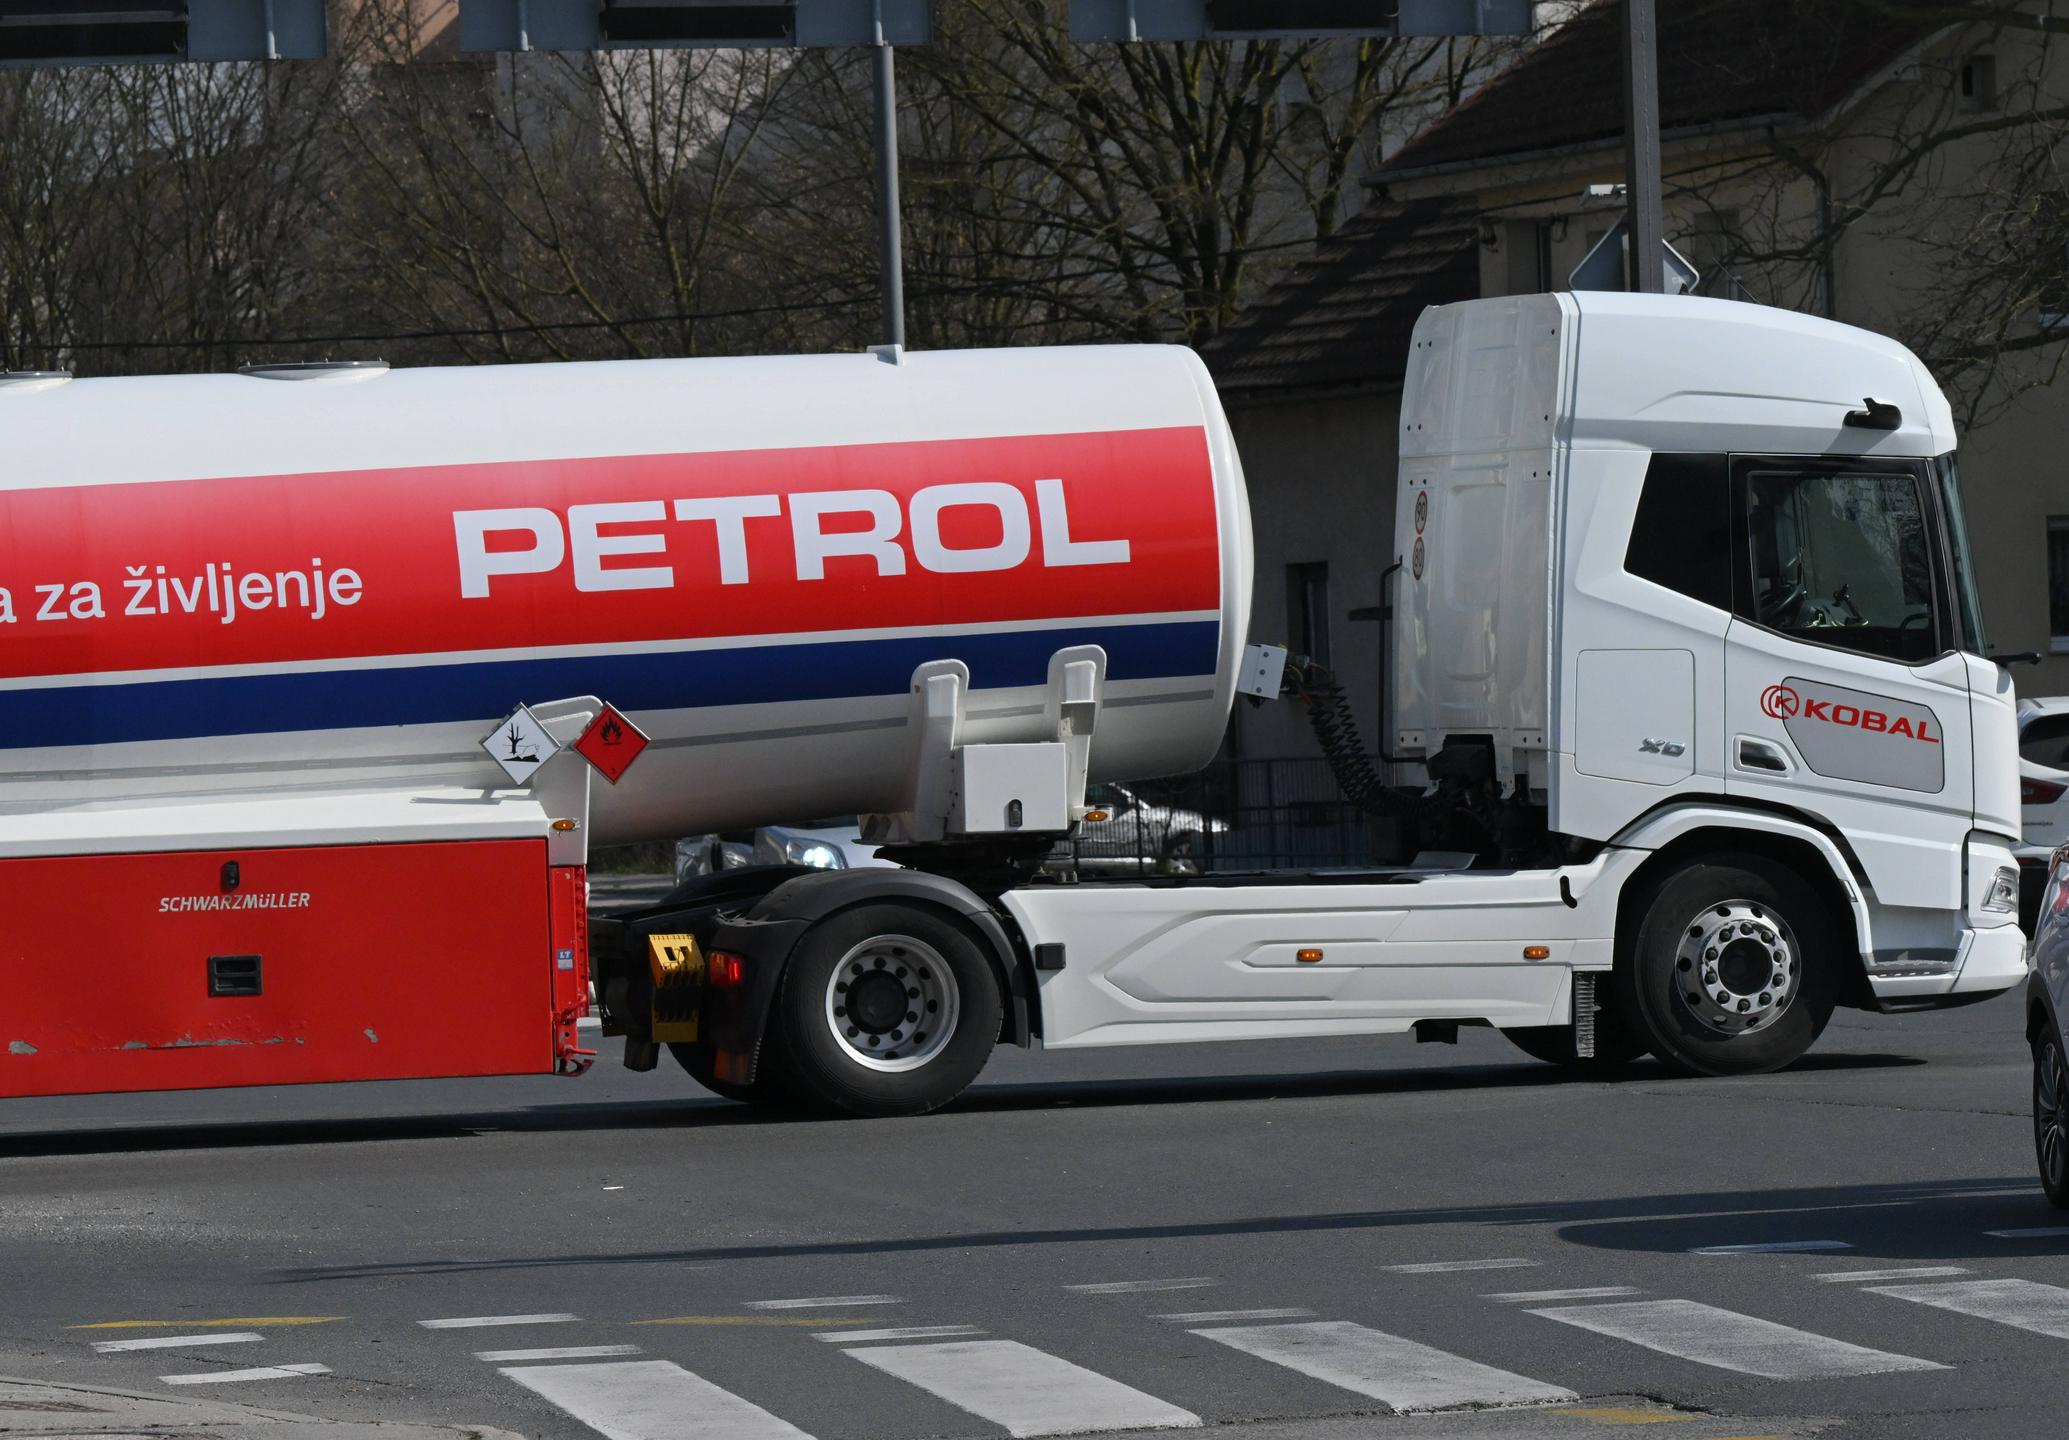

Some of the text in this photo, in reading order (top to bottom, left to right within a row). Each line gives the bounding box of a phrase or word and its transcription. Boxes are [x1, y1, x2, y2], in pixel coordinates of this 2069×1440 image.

[452, 478, 1131, 599] PETROL
[35, 581, 106, 621] za
[123, 557, 363, 624] življenje
[1804, 698, 1940, 743] KOBAL
[158, 893, 311, 913] SCHWARZMÜLLER
